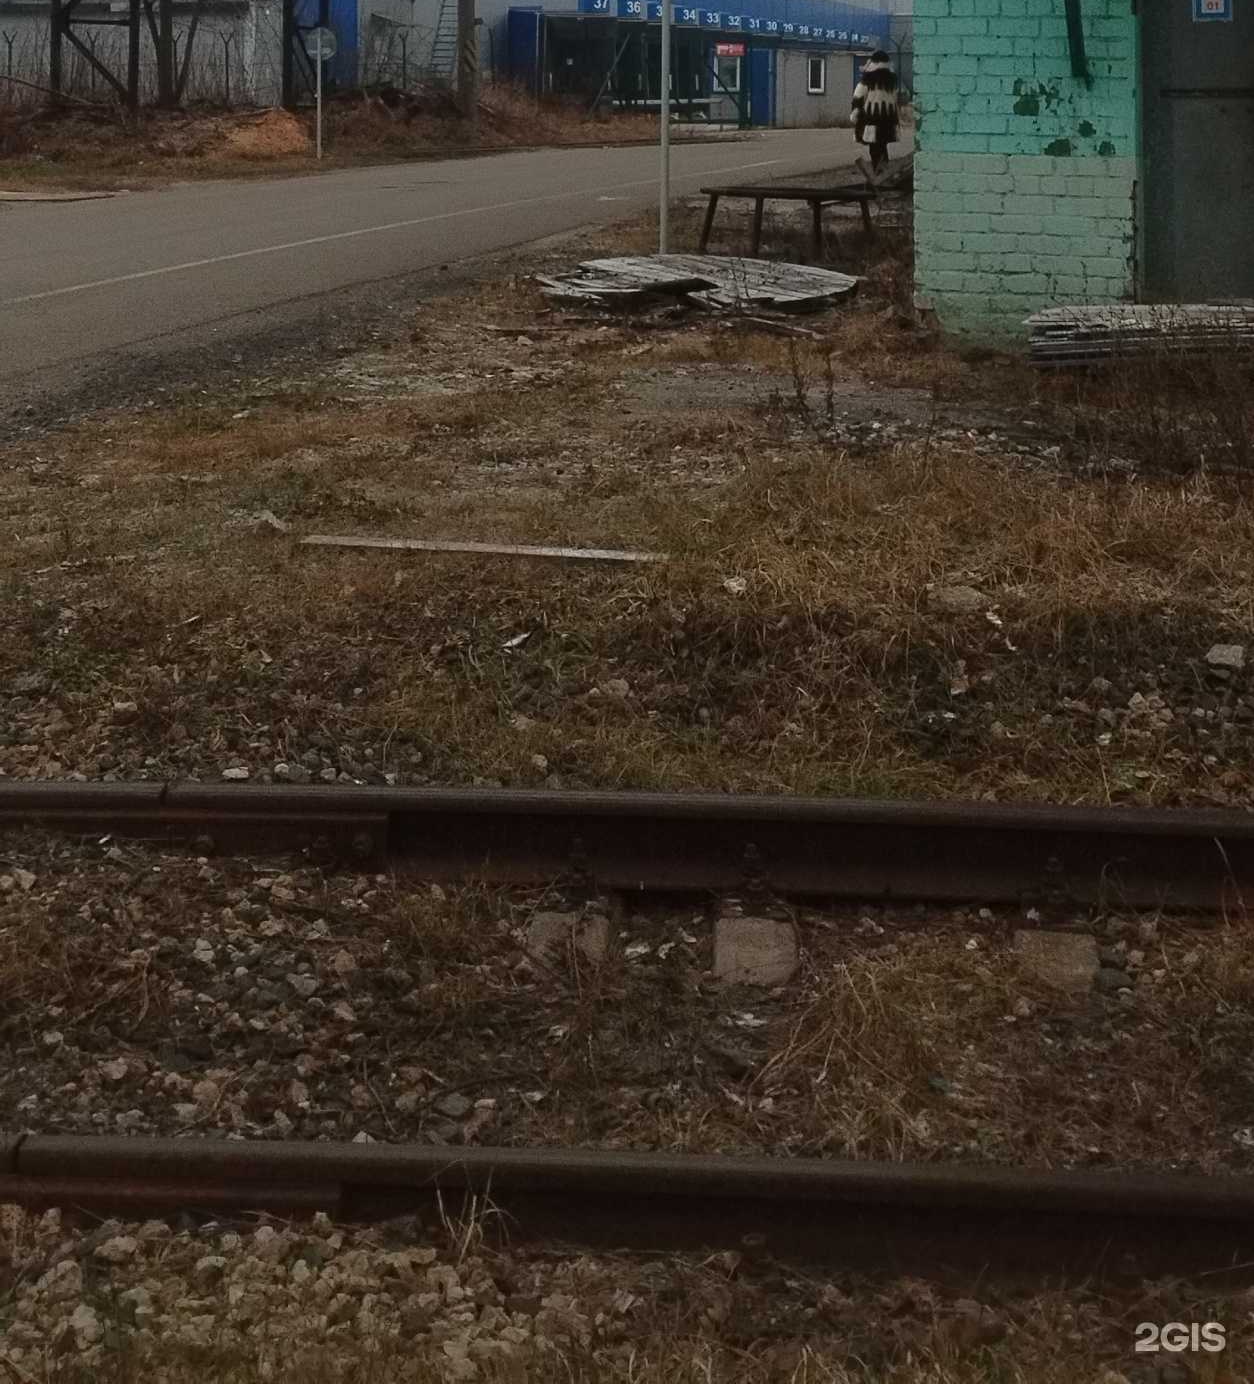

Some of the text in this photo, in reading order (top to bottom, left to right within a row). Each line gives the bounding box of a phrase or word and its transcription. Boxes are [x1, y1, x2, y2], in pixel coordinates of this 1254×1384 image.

[626, 1, 641, 13] 36
[683, 9, 696, 20] 34
[706, 13, 719, 23] 33
[728, 16, 740, 26] 32
[749, 19, 760, 29] 31
[766, 21, 777, 31] 30
[783, 23, 794, 33] 29
[799, 25, 809, 35] 28
[813, 27, 823, 36] 27
